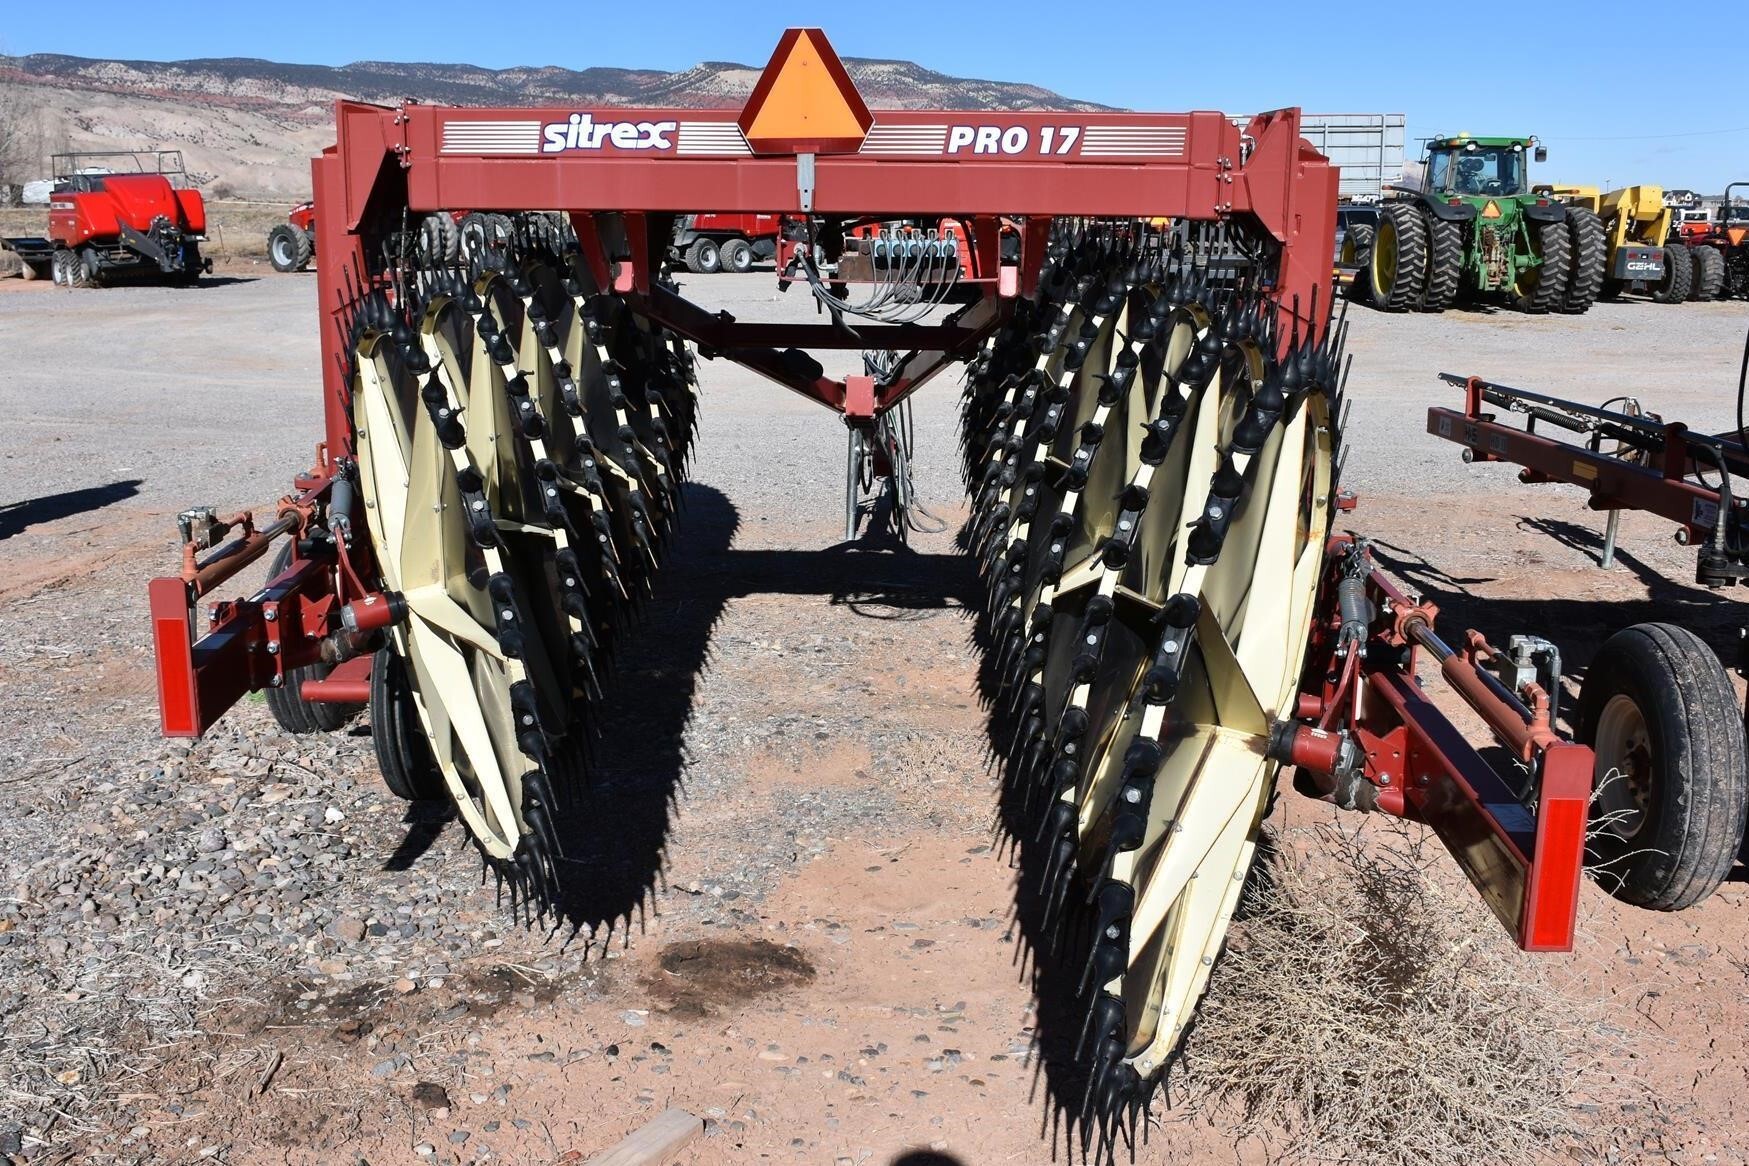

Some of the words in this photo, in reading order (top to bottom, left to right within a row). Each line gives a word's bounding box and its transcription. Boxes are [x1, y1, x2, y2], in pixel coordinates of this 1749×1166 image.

[541, 112, 677, 153] sitrex
[946, 125, 1030, 155] PRO
[1038, 126, 1082, 155] 17
[1627, 262, 1661, 270] GEHL
